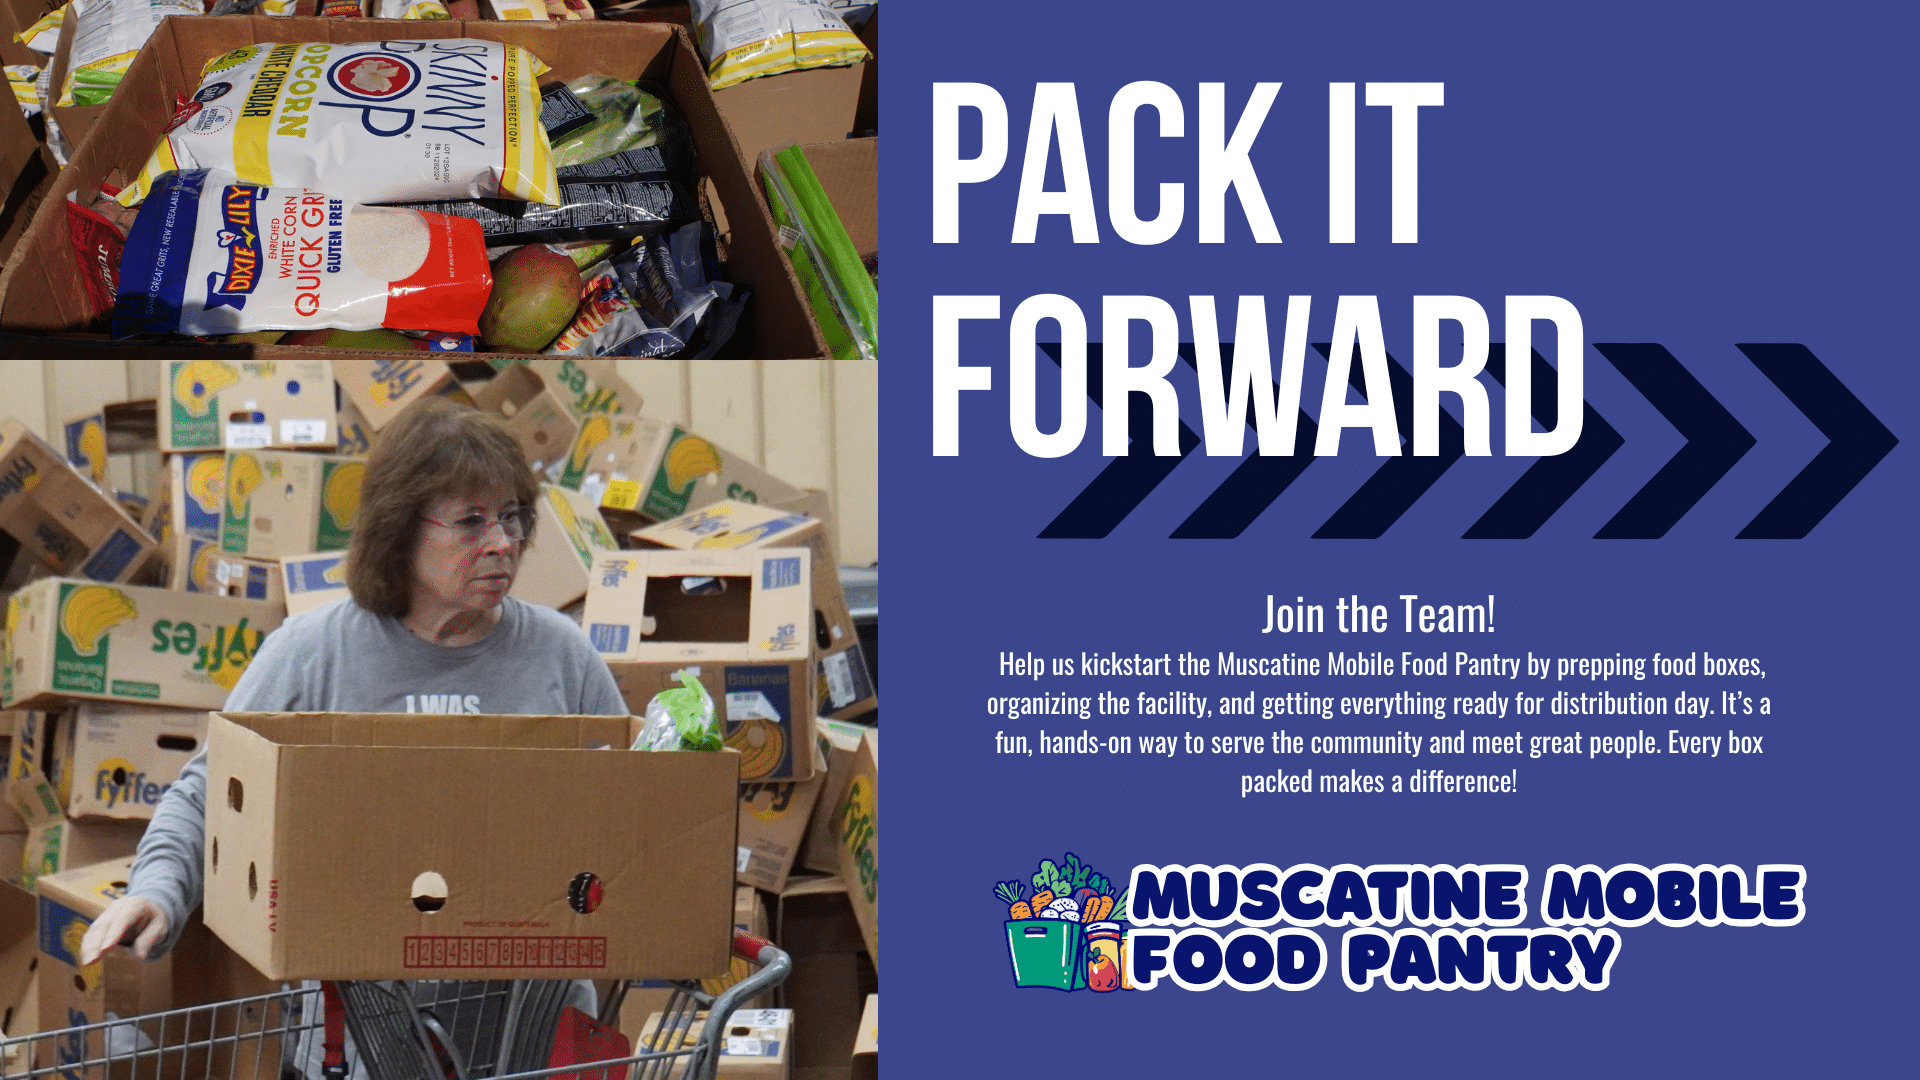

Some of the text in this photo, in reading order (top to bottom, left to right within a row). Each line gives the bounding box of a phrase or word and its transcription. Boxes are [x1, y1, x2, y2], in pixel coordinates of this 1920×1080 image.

[242, 44, 299, 117] WHITE CHEDDAR
[422, 43, 489, 146] SKINNY
[165, 190, 180, 229] RESEALABLE
[157, 246, 170, 268] GRITS,
[162, 229, 172, 246] NEW
[225, 186, 256, 291] DIXIE LILY
[268, 218, 280, 259] ENRICHED
[279, 196, 298, 279] WHITE CORN
[327, 199, 343, 274] GLUTEN FREE
[150, 268, 164, 292] GREAT
[294, 236, 324, 317] QUICK
[420, 694, 481, 715] WAS
[408, 938, 415, 961] 1
[422, 938, 430, 961] 2
[434, 938, 443, 961] 3
[448, 938, 456, 961] 4
[461, 938, 470, 961] 5
[475, 938, 484, 961] 6
[489, 938, 498, 961] 7
[502, 938, 510, 961] 8
[515, 938, 524, 961] 9
